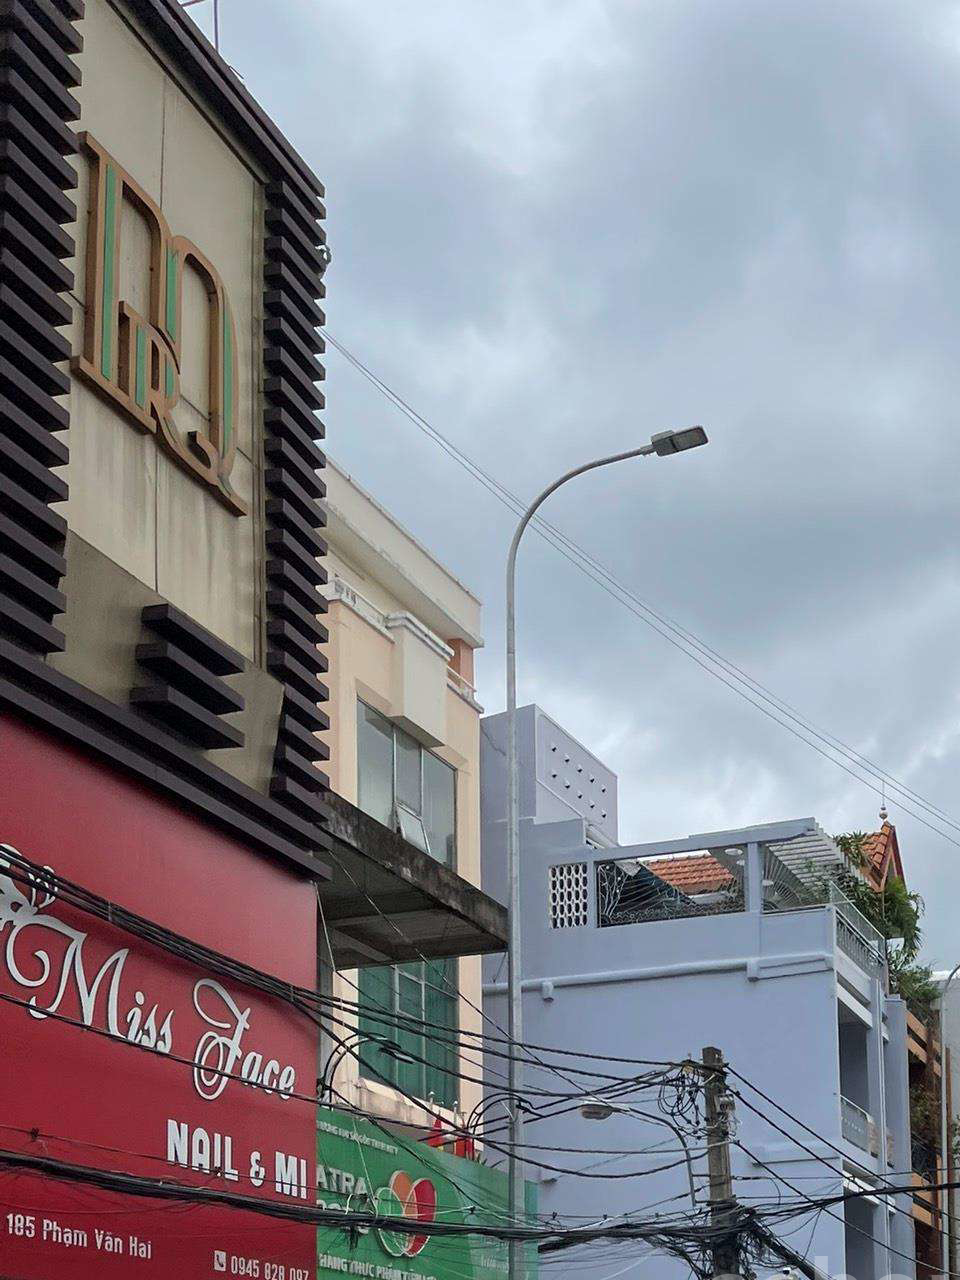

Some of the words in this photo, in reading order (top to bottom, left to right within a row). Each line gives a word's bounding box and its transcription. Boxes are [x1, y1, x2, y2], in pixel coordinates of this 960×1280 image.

[6, 914, 175, 1055] Miss
[193, 978, 297, 1100] Face
[167, 1119, 239, 1181] NAIL
[250, 1151, 265, 1187] &
[275, 1151, 307, 1199] MI
[6, 1213, 36, 1238] 185
[43, 1218, 88, 1248] Phạm
[129, 1235, 152, 1259] Hai
[230, 1255, 260, 1278] 0945
